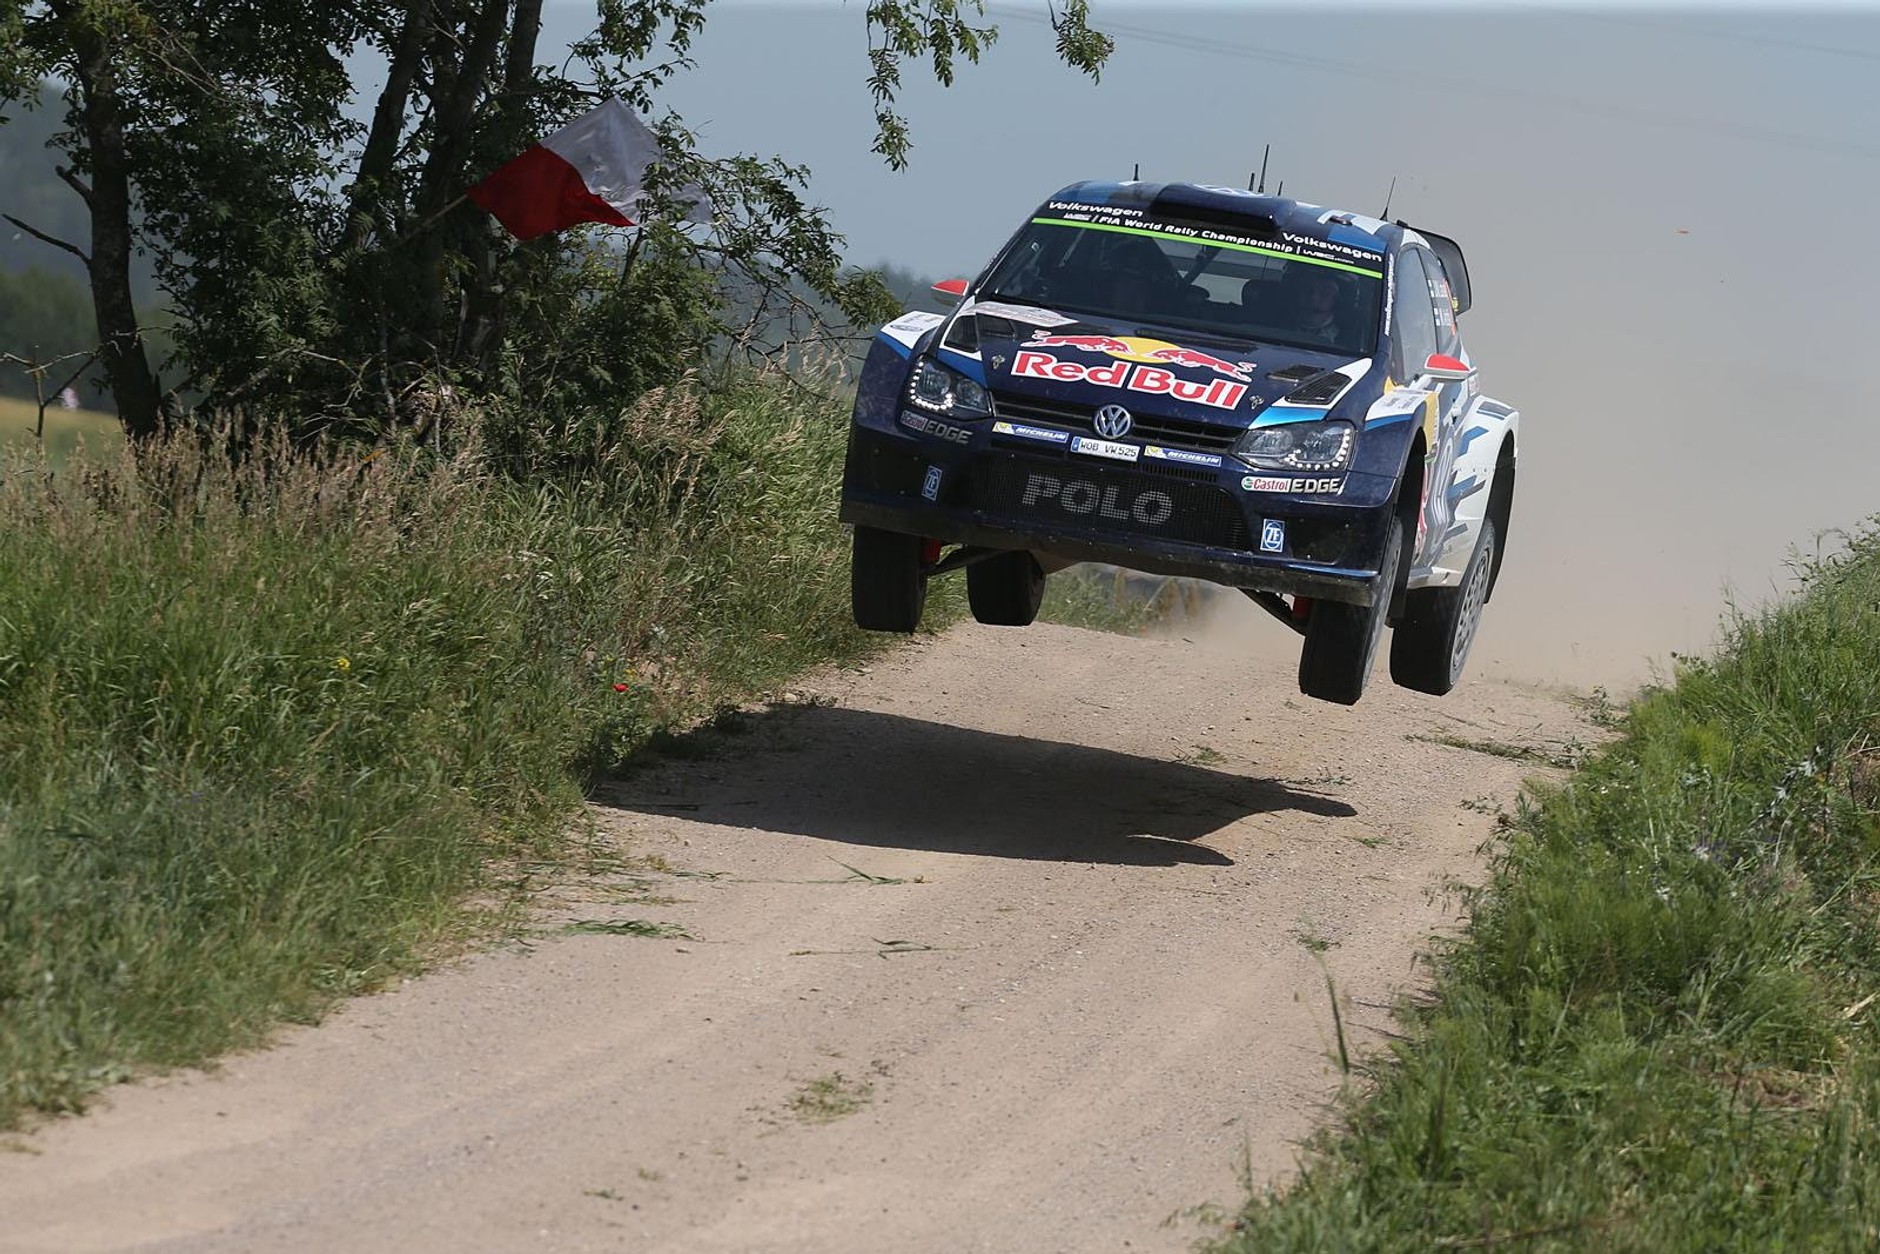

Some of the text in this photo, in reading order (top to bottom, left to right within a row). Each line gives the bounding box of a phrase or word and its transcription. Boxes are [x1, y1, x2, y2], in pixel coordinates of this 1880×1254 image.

[1048, 201, 1143, 218] Volkswagen
[1098, 215, 1121, 226] FIA
[1124, 218, 1163, 232] World
[1164, 224, 1199, 238] Rally
[1201, 230, 1293, 254] Championship
[1282, 231, 1383, 263] Volkswagen
[1013, 352, 1247, 409] Red Bull
[924, 420, 974, 445] EDGE
[1015, 426, 1067, 442] MICHELIN
[1080, 441, 1099, 451] WOB
[1166, 450, 1221, 466] MICHELIN
[1253, 478, 1341, 493] Castrol EDGE
[1021, 472, 1173, 526] POLO
